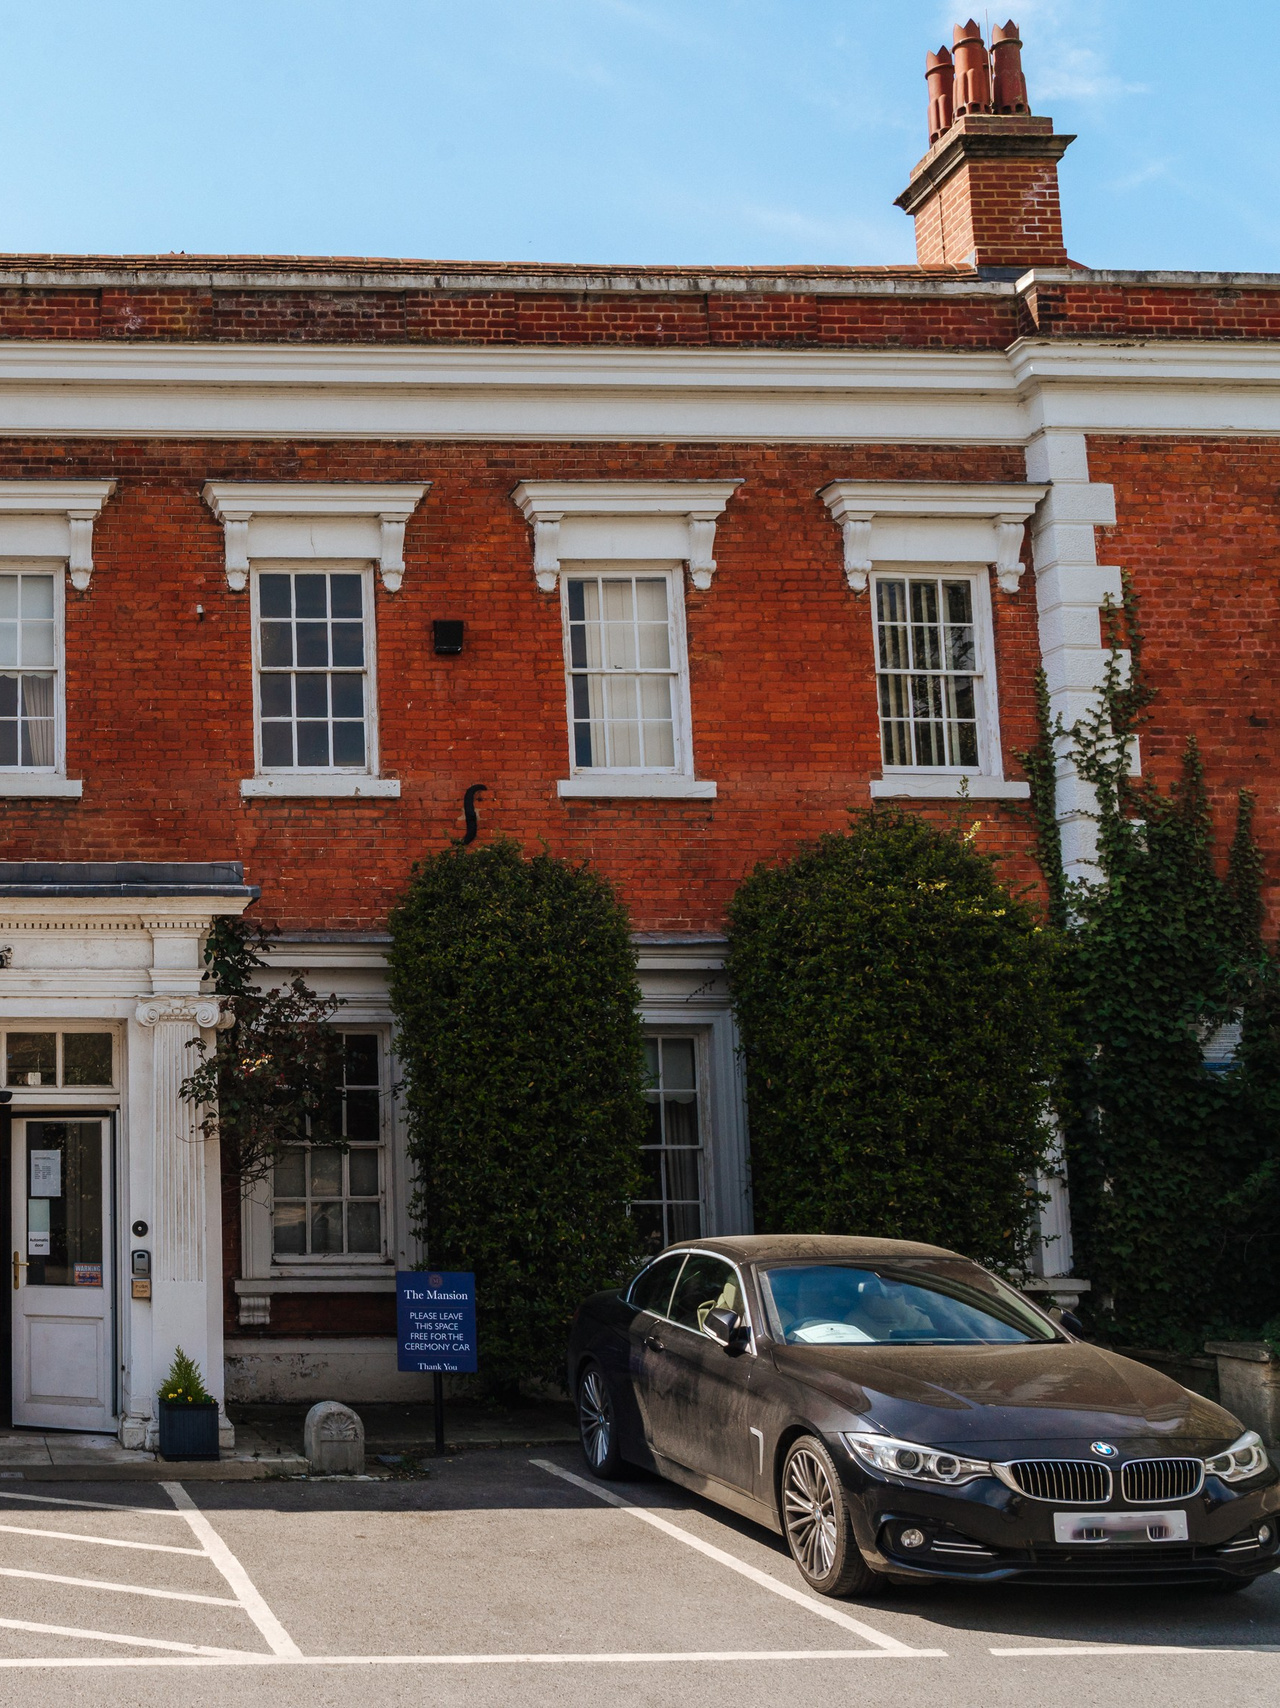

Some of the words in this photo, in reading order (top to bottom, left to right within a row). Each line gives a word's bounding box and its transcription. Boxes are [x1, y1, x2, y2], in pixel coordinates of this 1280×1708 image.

[403, 1290, 424, 1300] The
[426, 1290, 468, 1300] Mansion
[409, 1312, 437, 1320] PLEASE
[439, 1312, 463, 1320] LEAVE
[414, 1322, 433, 1330] THIS
[434, 1322, 459, 1331] SPACE
[410, 1332, 428, 1340] FREE
[430, 1333, 447, 1341] FOR
[447, 1333, 464, 1341] THE
[404, 1342, 451, 1351] CEREMONY
[452, 1343, 471, 1351] CAR
[417, 1362, 442, 1370] Thank
[443, 1363, 458, 1371] You
